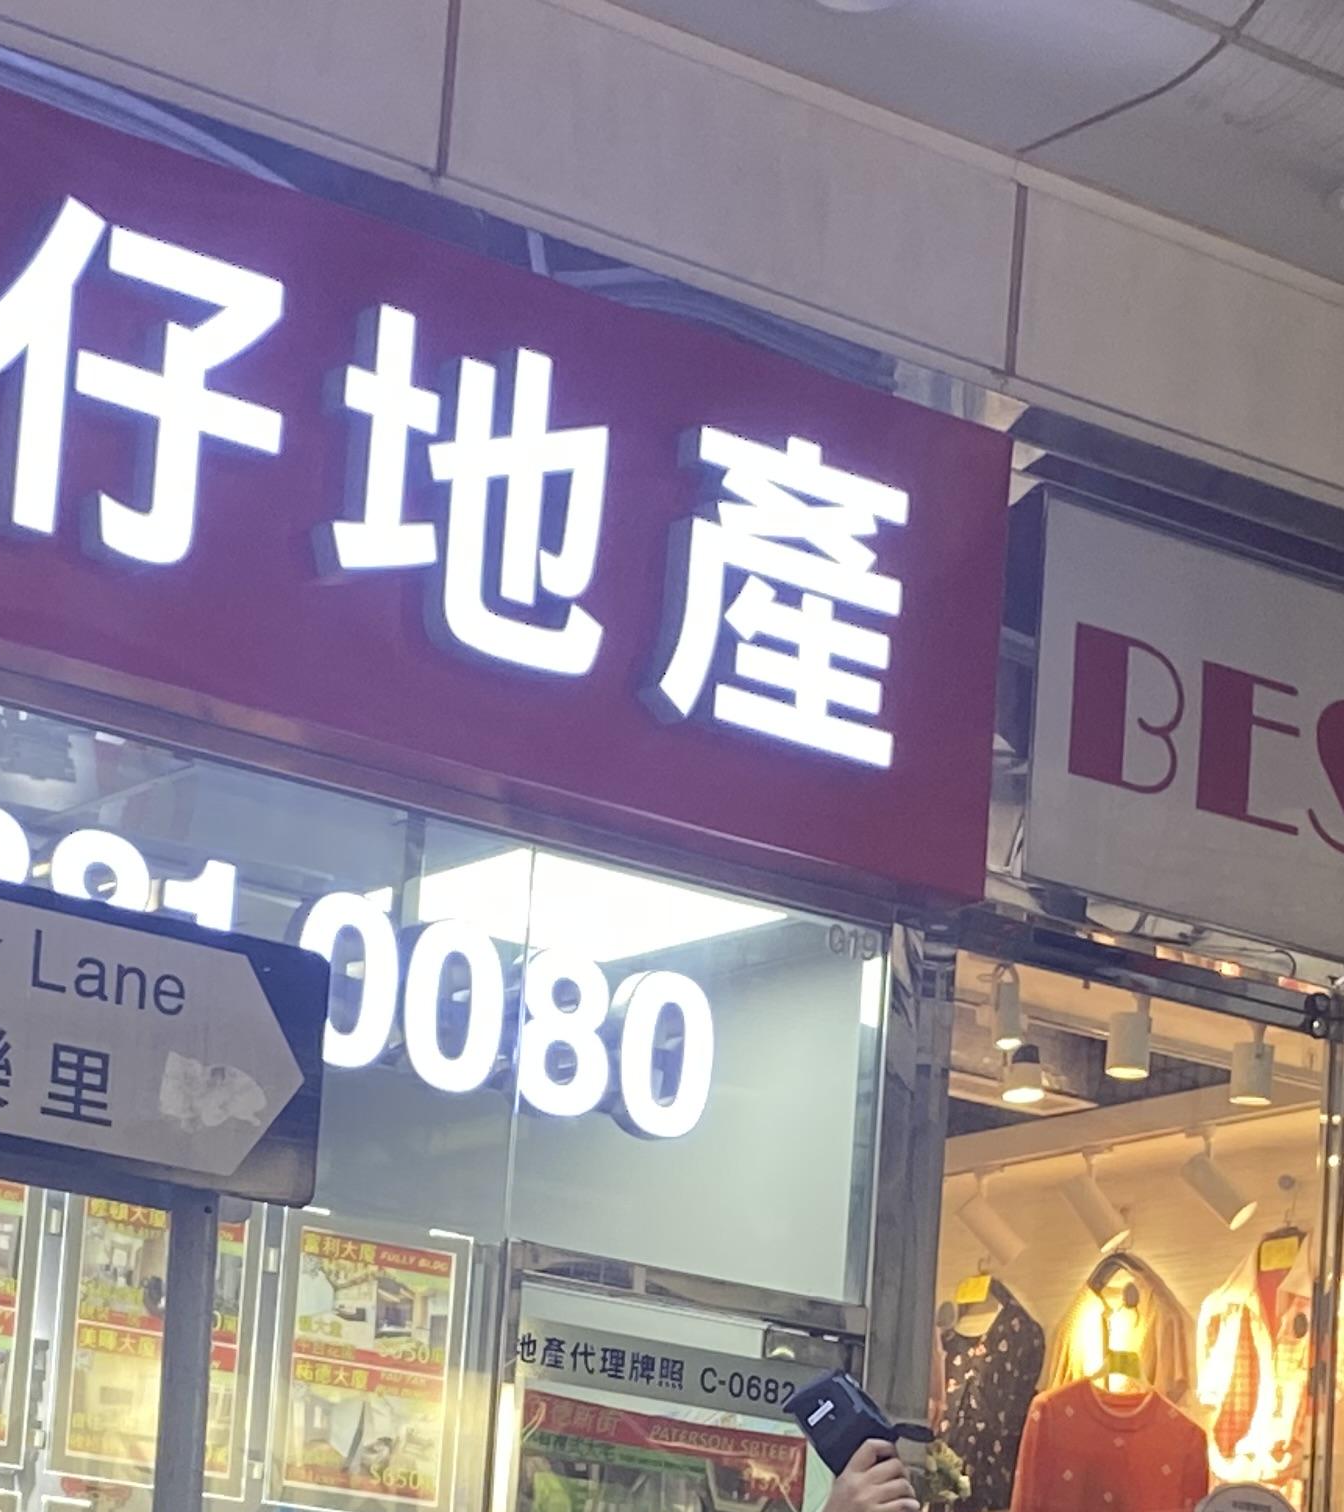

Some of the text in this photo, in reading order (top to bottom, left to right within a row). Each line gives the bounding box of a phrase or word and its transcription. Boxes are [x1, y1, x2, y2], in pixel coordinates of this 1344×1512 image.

[31, 928, 187, 1017] Lane
[299, 891, 716, 1141] 0080
[516, 1332, 685, 1392] 地產代理牌照
